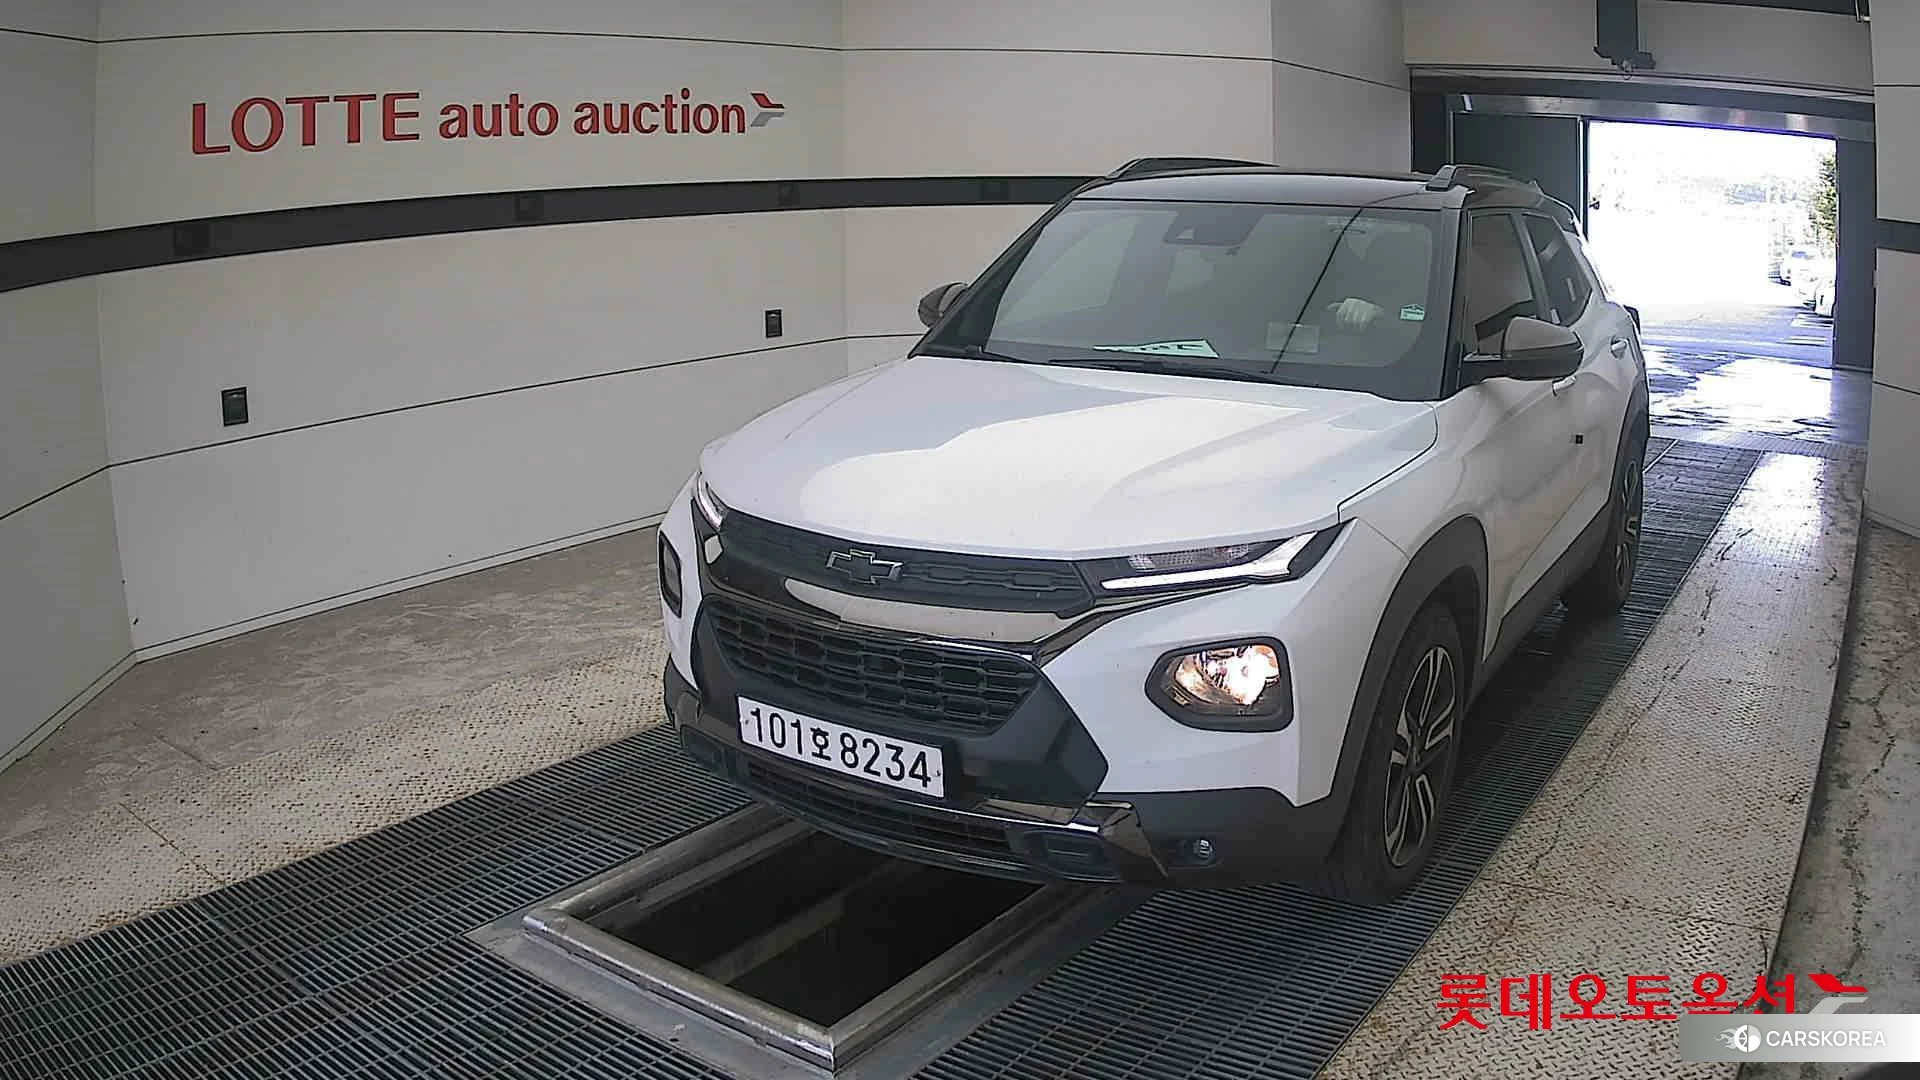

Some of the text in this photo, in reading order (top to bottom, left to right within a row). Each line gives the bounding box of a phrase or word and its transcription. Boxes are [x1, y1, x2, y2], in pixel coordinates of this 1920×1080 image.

[191, 88, 746, 155] LOTTE auto auction
